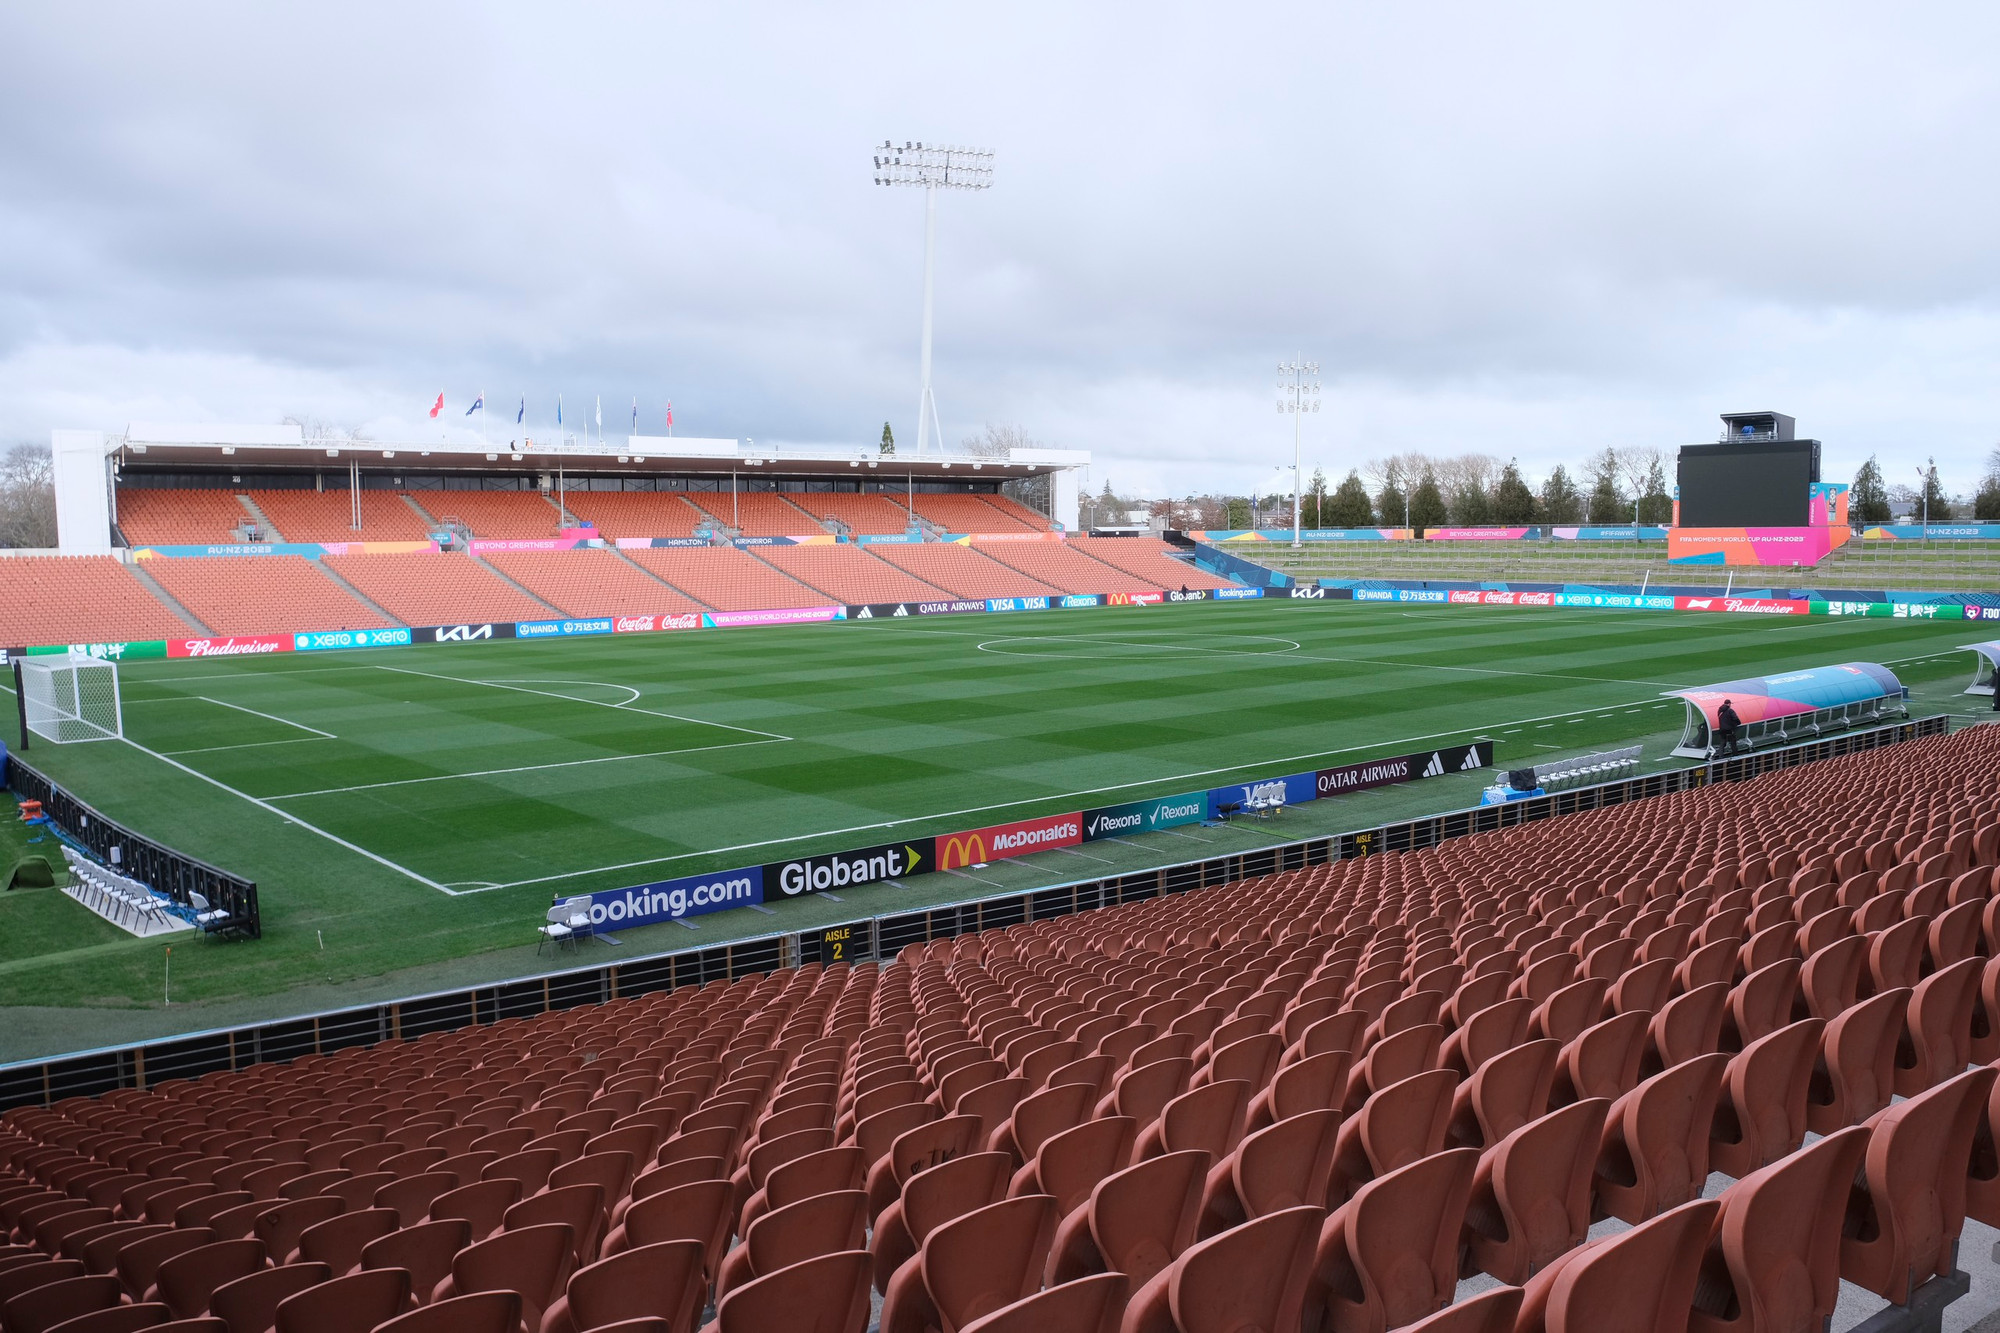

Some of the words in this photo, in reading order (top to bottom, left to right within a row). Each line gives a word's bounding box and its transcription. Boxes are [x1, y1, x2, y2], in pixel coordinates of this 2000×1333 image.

[473, 541, 506, 550] BEYOND
[508, 540, 555, 549] GREATNESS
[1130, 593, 1161, 602] McDonald's
[1219, 588, 1257, 599] Booking.com
[1291, 588, 1325, 599] KIA
[1367, 591, 1393, 600] WANDA
[919, 603, 949, 614] QATAR
[950, 600, 985, 611] AIRWAYS
[991, 598, 1015, 611] VISA
[1022, 597, 1046, 609] VISA
[1067, 596, 1097, 607] Rexona
[1566, 595, 1592, 605] xero
[1605, 596, 1632, 606] xero
[1646, 597, 1672, 607] xero
[1724, 599, 1794, 614] Budweiser
[730, 614, 759, 622] WOMEN'S
[759, 613, 780, 621] WORLD
[780, 612, 793, 620] CUP
[435, 624, 492, 642] KIA
[530, 624, 559, 634] WANDA
[313, 632, 351, 647] xero
[372, 629, 408, 643] xero
[185, 638, 279, 657] Budweiser
[1317, 773, 1358, 793] QATAR
[1359, 761, 1408, 784] AIRWAYS
[1100, 812, 1142, 832] Rexona
[1160, 801, 1200, 821] Rexona
[992, 821, 1078, 852] McDonald's
[1355, 833, 1372, 844] AISLE
[1360, 844, 1367, 857] 3
[780, 848, 903, 895] Globant
[590, 875, 751, 925] ooking.com
[824, 927, 851, 942] AISLE
[832, 943, 843, 960] 2
